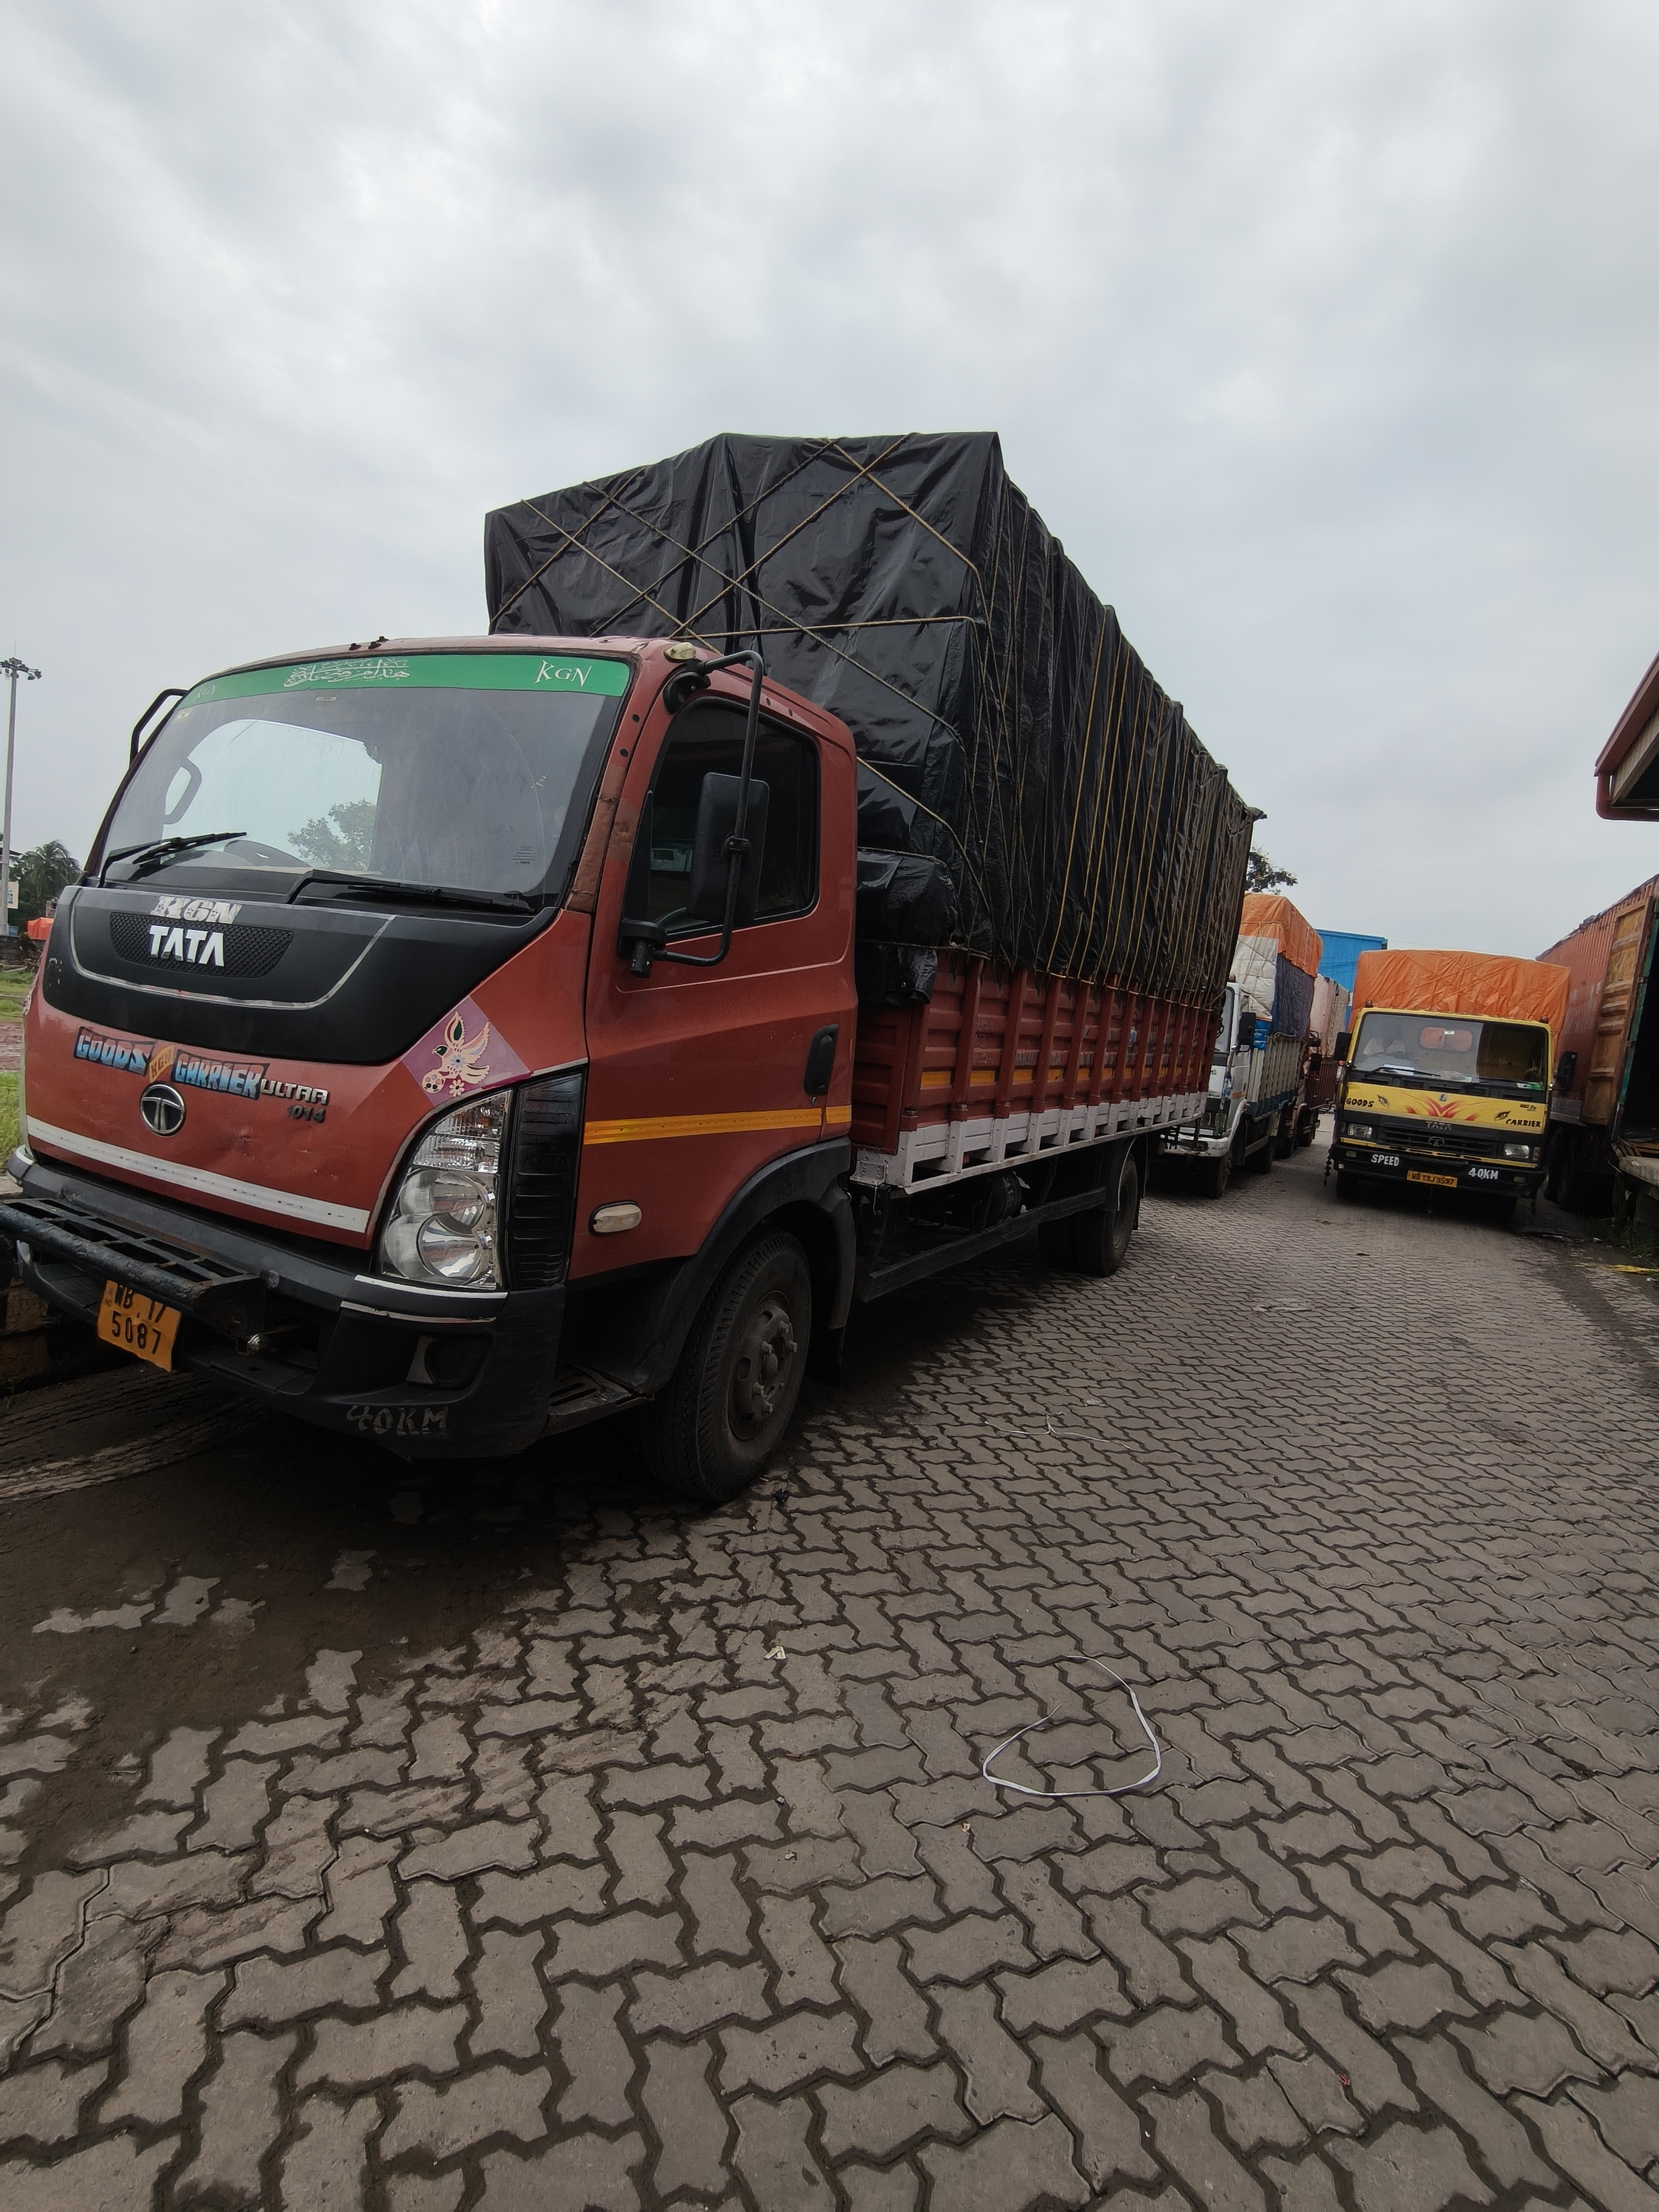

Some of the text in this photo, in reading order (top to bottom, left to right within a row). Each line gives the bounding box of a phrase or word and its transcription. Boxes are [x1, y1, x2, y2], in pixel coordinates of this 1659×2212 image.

[533, 659, 593, 687] KGN
[150, 895, 242, 925] KGN
[149, 925, 224, 967] TATA
[74, 1027, 153, 1076] GOODS
[260, 1078, 329, 1105] ULTRA
[1346, 1098, 1375, 1108] GOODS
[287, 1105, 326, 1123] 1014
[1506, 1118, 1541, 1128] CARRIER
[1371, 1154, 1400, 1166] SPEED
[111, 1310, 161, 1355] 5087
[346, 1405, 449, 1437] 40KM
